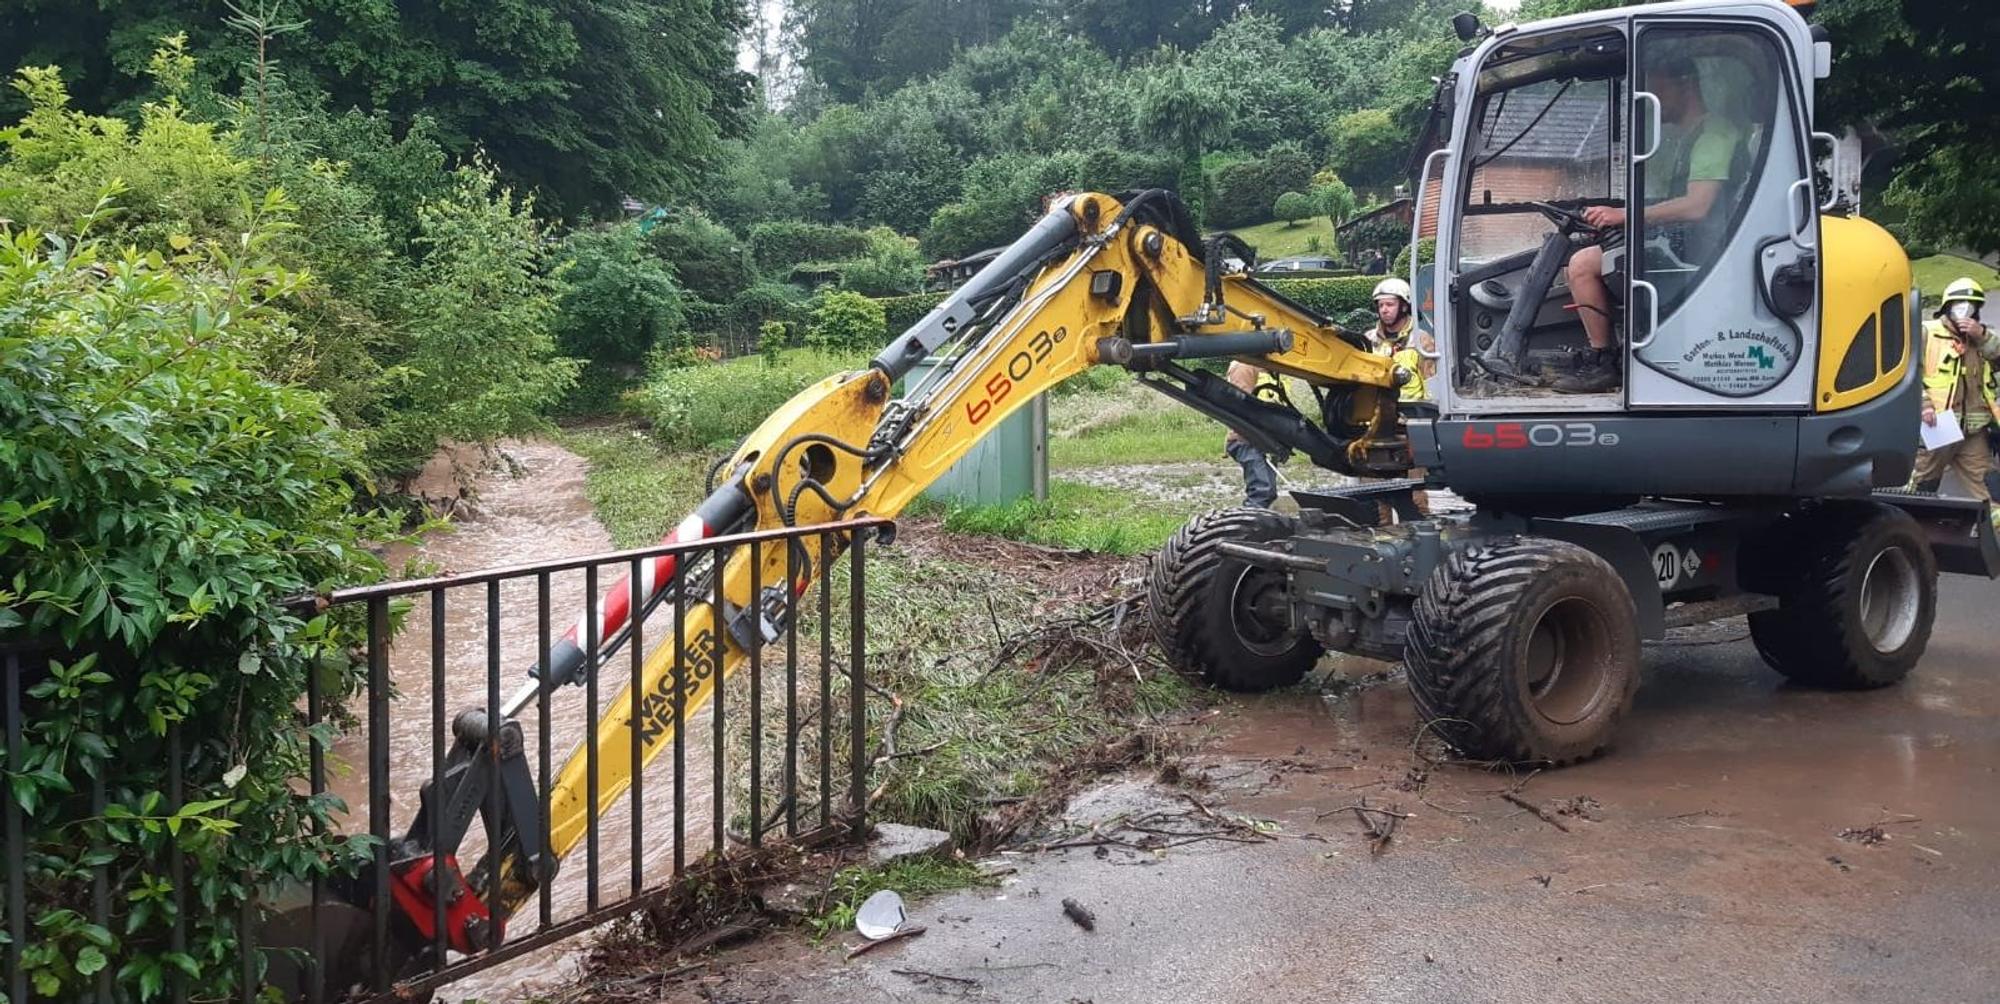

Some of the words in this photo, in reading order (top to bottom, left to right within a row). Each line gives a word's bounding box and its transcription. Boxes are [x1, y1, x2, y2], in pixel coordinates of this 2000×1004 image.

[1717, 331, 1726, 341] &
[1729, 328, 1794, 361] Landschaftsbau
[1658, 551, 1674, 581] 20
